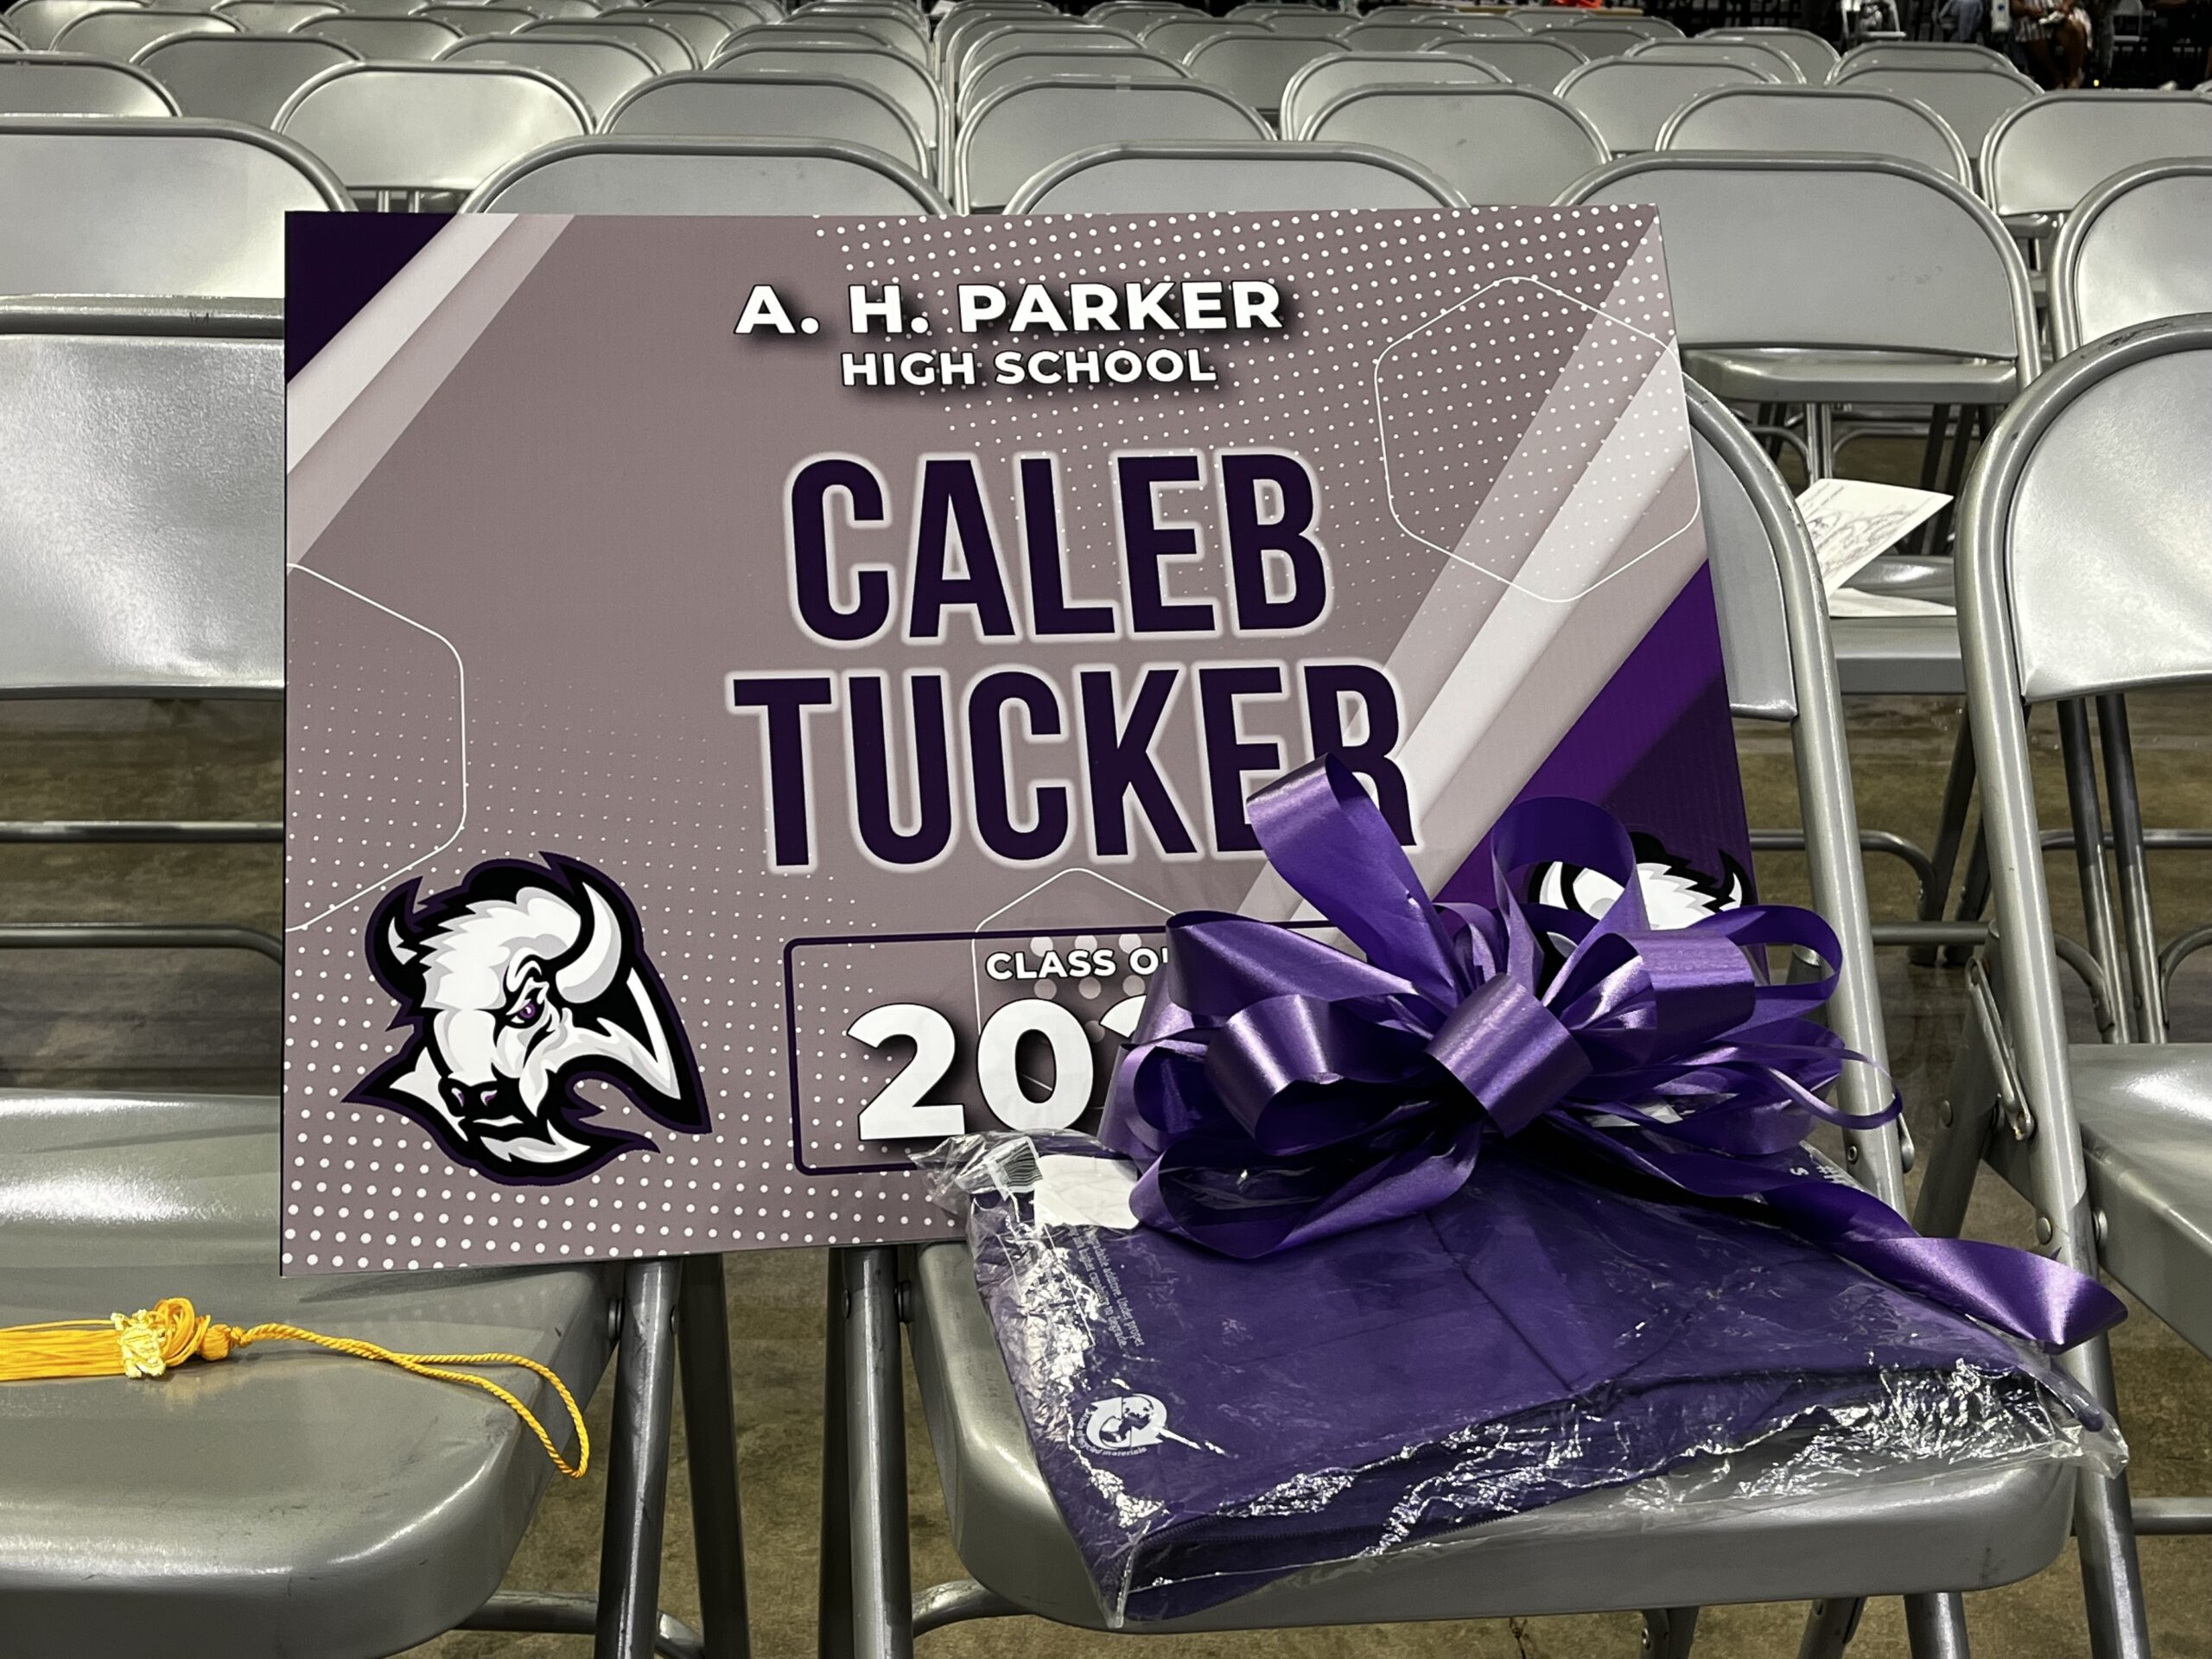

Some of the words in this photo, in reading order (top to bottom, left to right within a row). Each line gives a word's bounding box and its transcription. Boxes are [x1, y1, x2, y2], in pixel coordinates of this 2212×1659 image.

[733, 283, 820, 335] A.
[848, 283, 931, 335] H.
[957, 279, 1284, 334] PARKER
[841, 351, 976, 386] HIGH
[995, 348, 1217, 385] SCHOOL
[787, 448, 1332, 645] CALEB
[986, 948, 1116, 981] CLASS
[1128, 946, 1168, 976] O
[846, 995, 1147, 1141] 20
